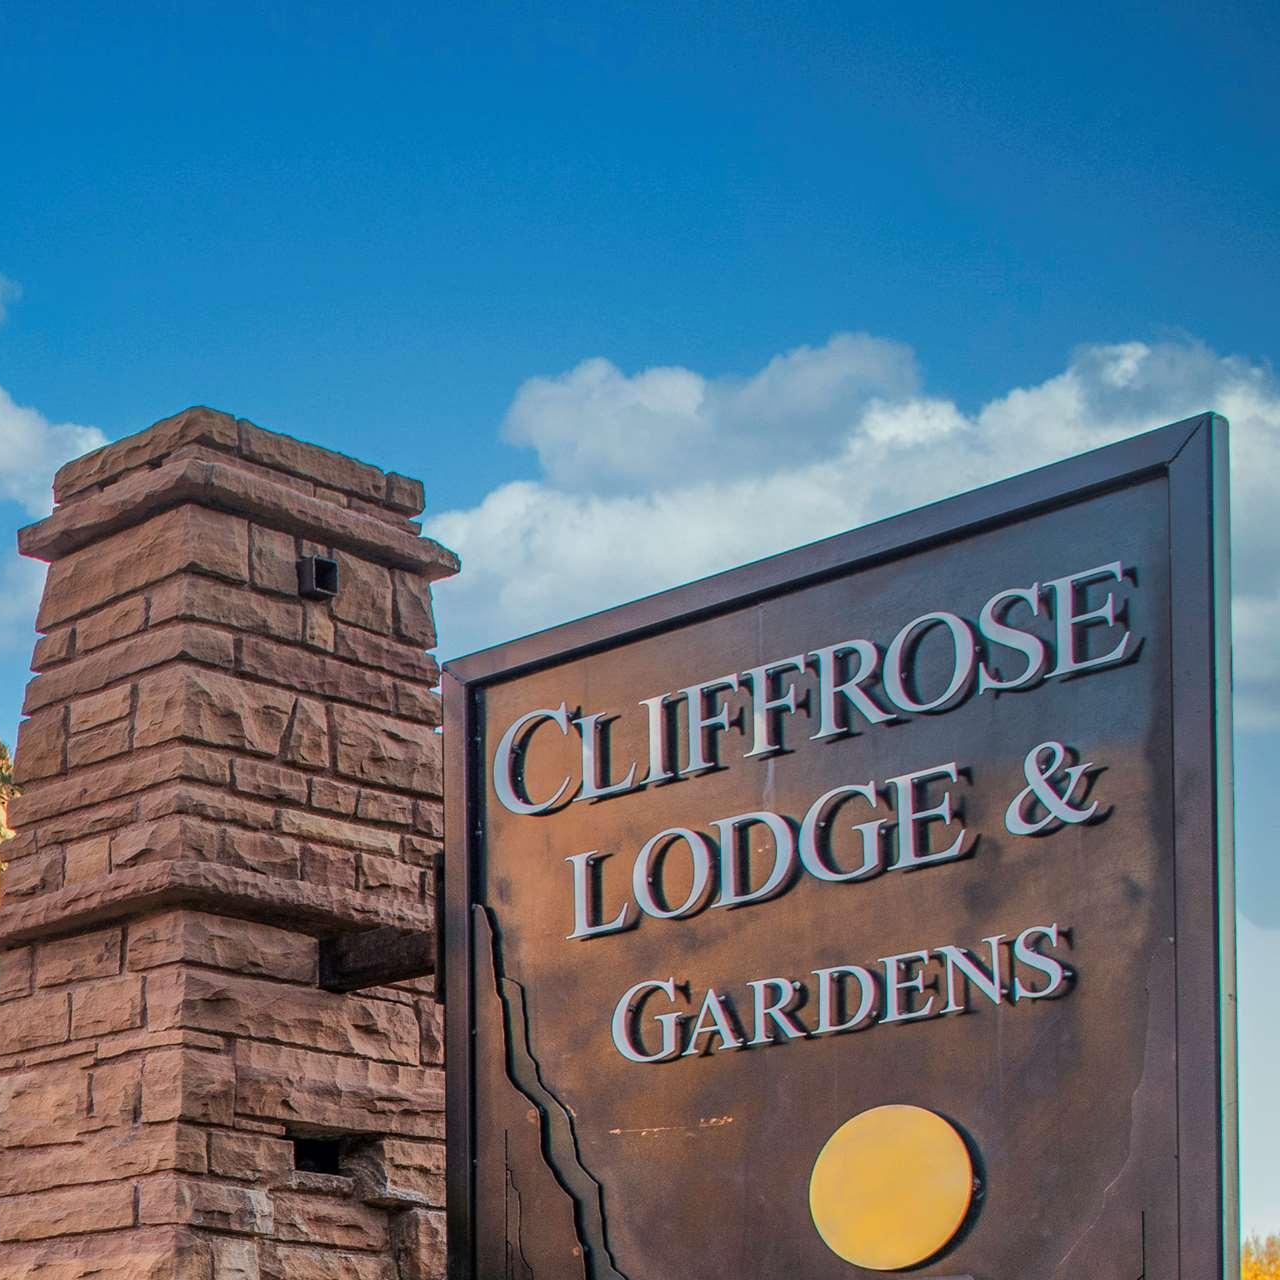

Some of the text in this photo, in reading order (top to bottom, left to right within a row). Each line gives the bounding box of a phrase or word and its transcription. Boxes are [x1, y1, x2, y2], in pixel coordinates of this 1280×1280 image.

[493, 561, 1135, 816] CLIFFROSE
[565, 741, 1100, 941] LODGE &
[611, 923, 1068, 1063] GARDENS
